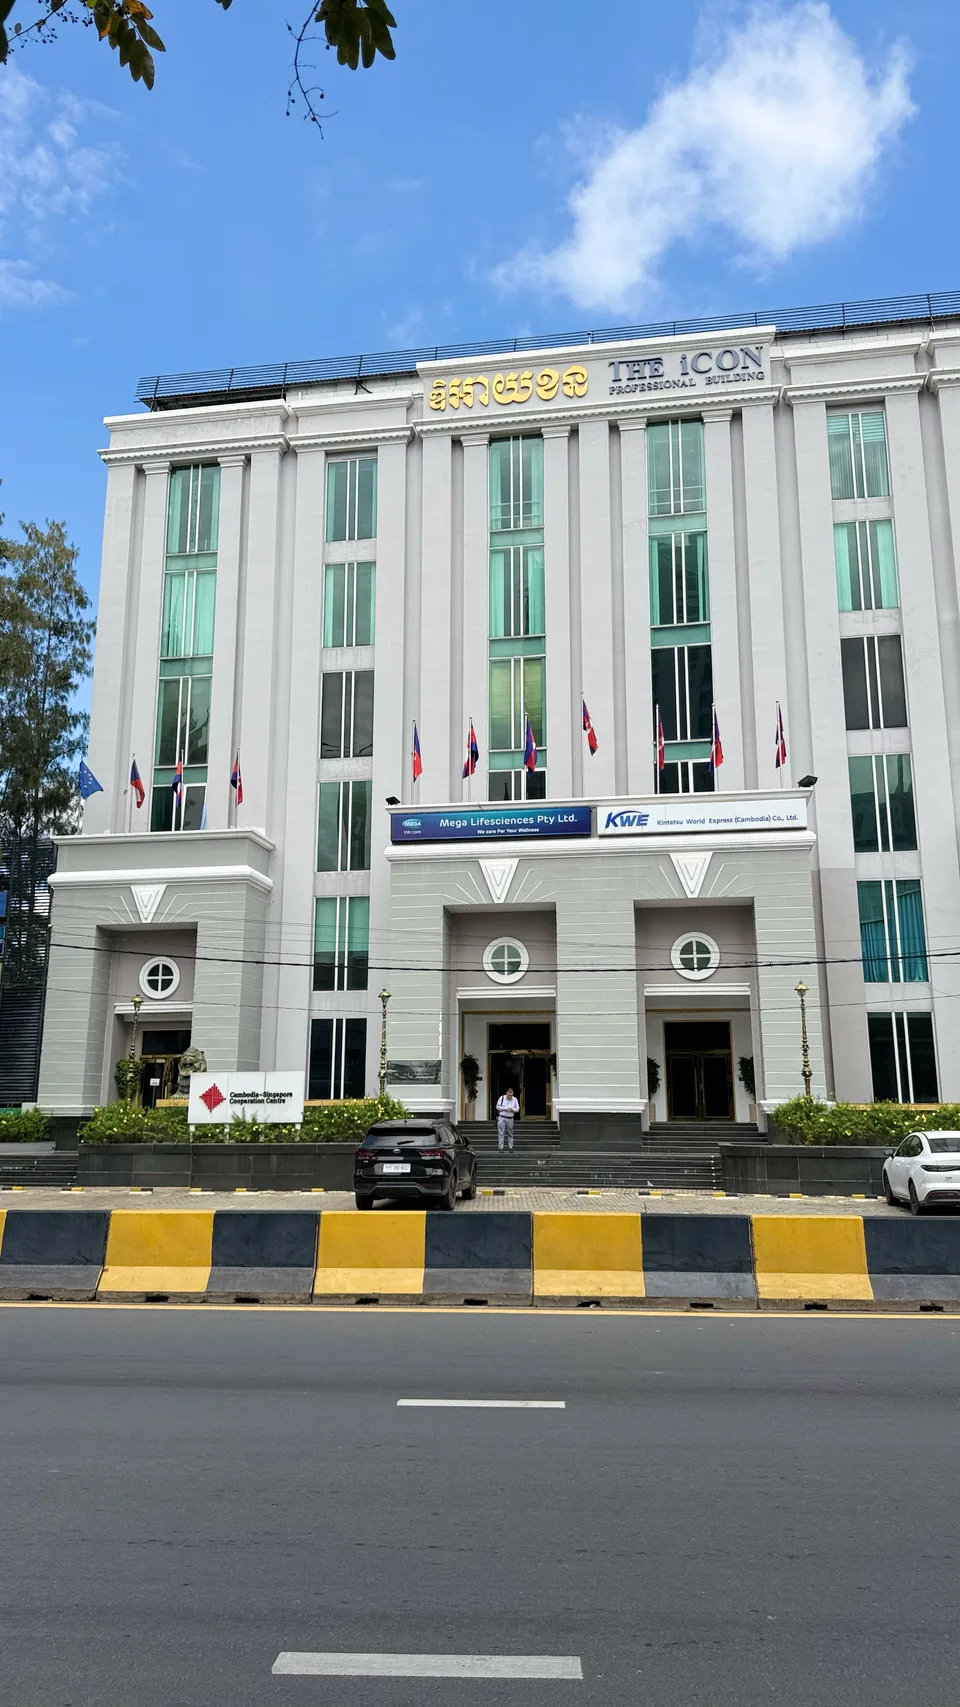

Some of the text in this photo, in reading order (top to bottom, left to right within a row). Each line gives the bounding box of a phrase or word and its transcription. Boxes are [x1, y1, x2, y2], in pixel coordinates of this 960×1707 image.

[608, 357, 665, 382] THE
[609, 371, 765, 395] PROFESSIONAL BUILDING
[440, 814, 578, 829] Mega Lifesciences Pty Ltd.
[605, 810, 650, 829] KWE
